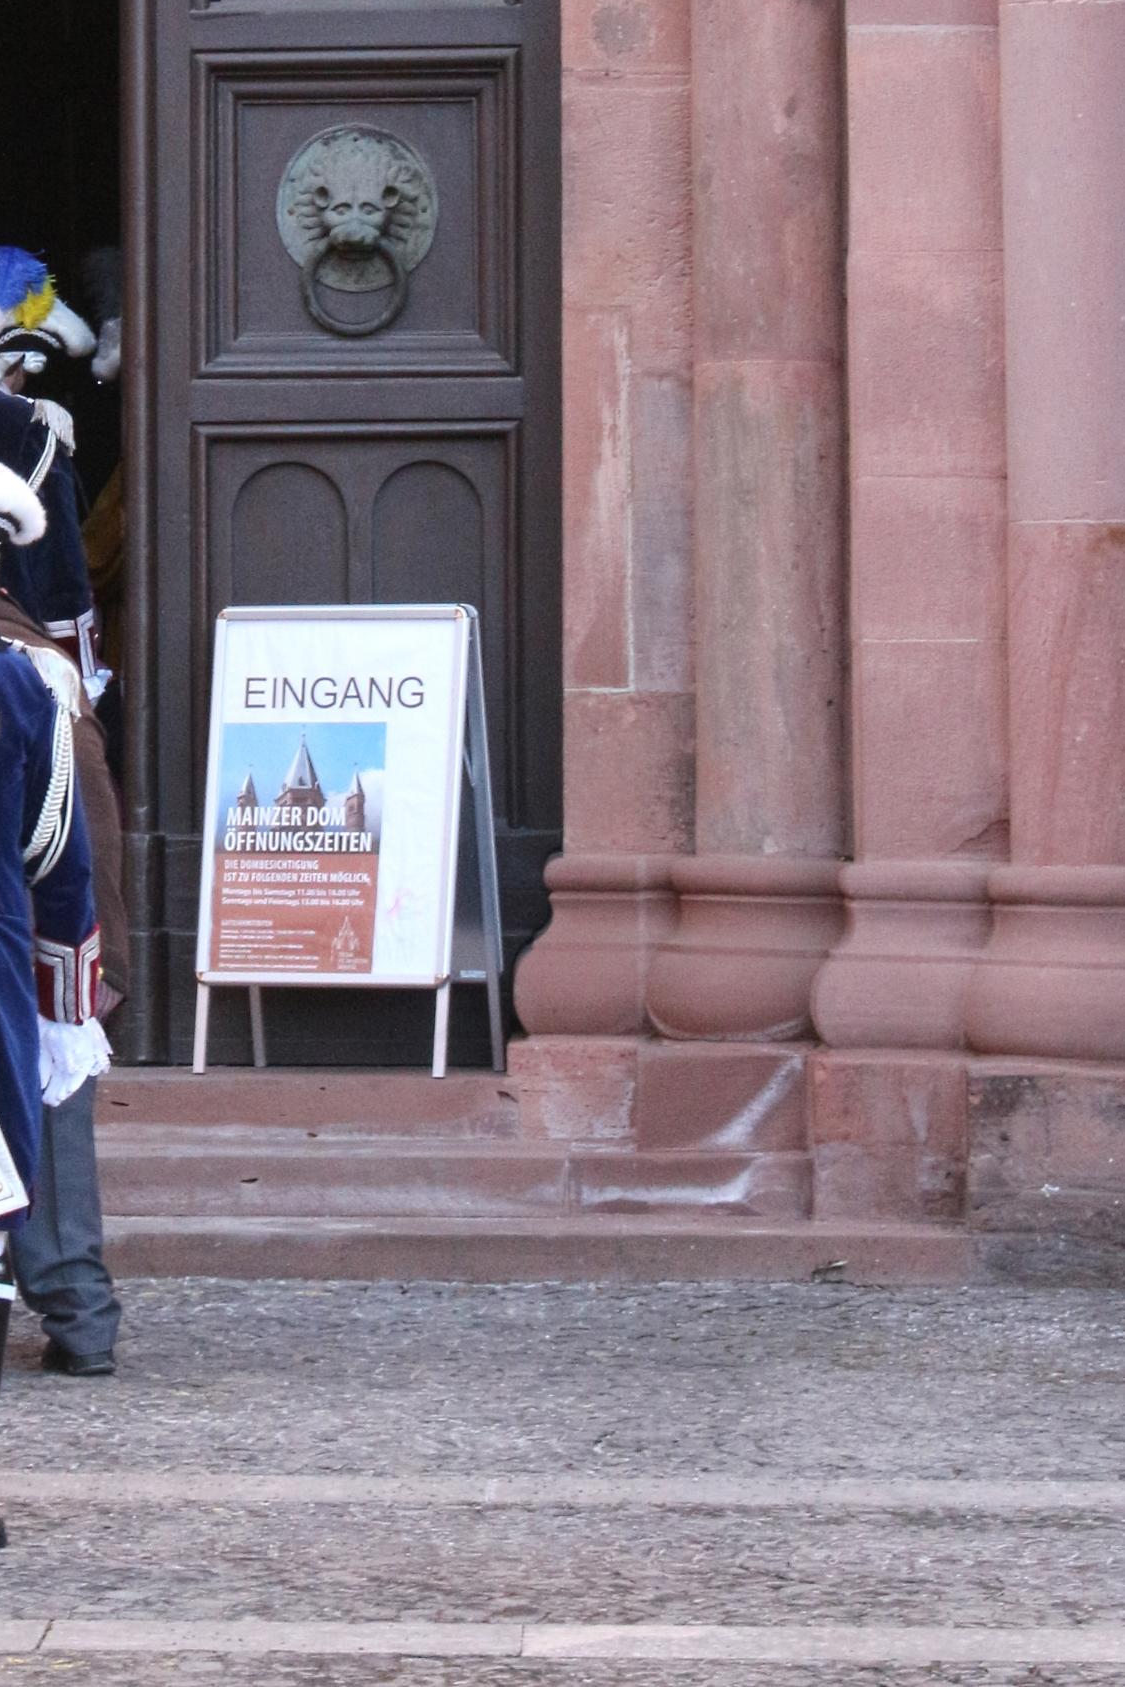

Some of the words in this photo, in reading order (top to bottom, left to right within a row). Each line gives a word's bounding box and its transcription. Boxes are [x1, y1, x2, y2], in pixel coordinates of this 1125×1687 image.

[245, 676, 425, 710] EINGANG
[226, 806, 301, 826] MAINZER
[306, 807, 346, 827] DOM
[224, 828, 372, 852] ÖFFNUNGSZEITEN
[224, 859, 239, 869] DIE
[240, 859, 319, 871] DOMBESICHTIGUNG
[223, 872, 237, 882] IST
[238, 872, 249, 883] ZU
[251, 872, 298, 883] FOLGENDEN
[299, 872, 328, 883] ZEITEN
